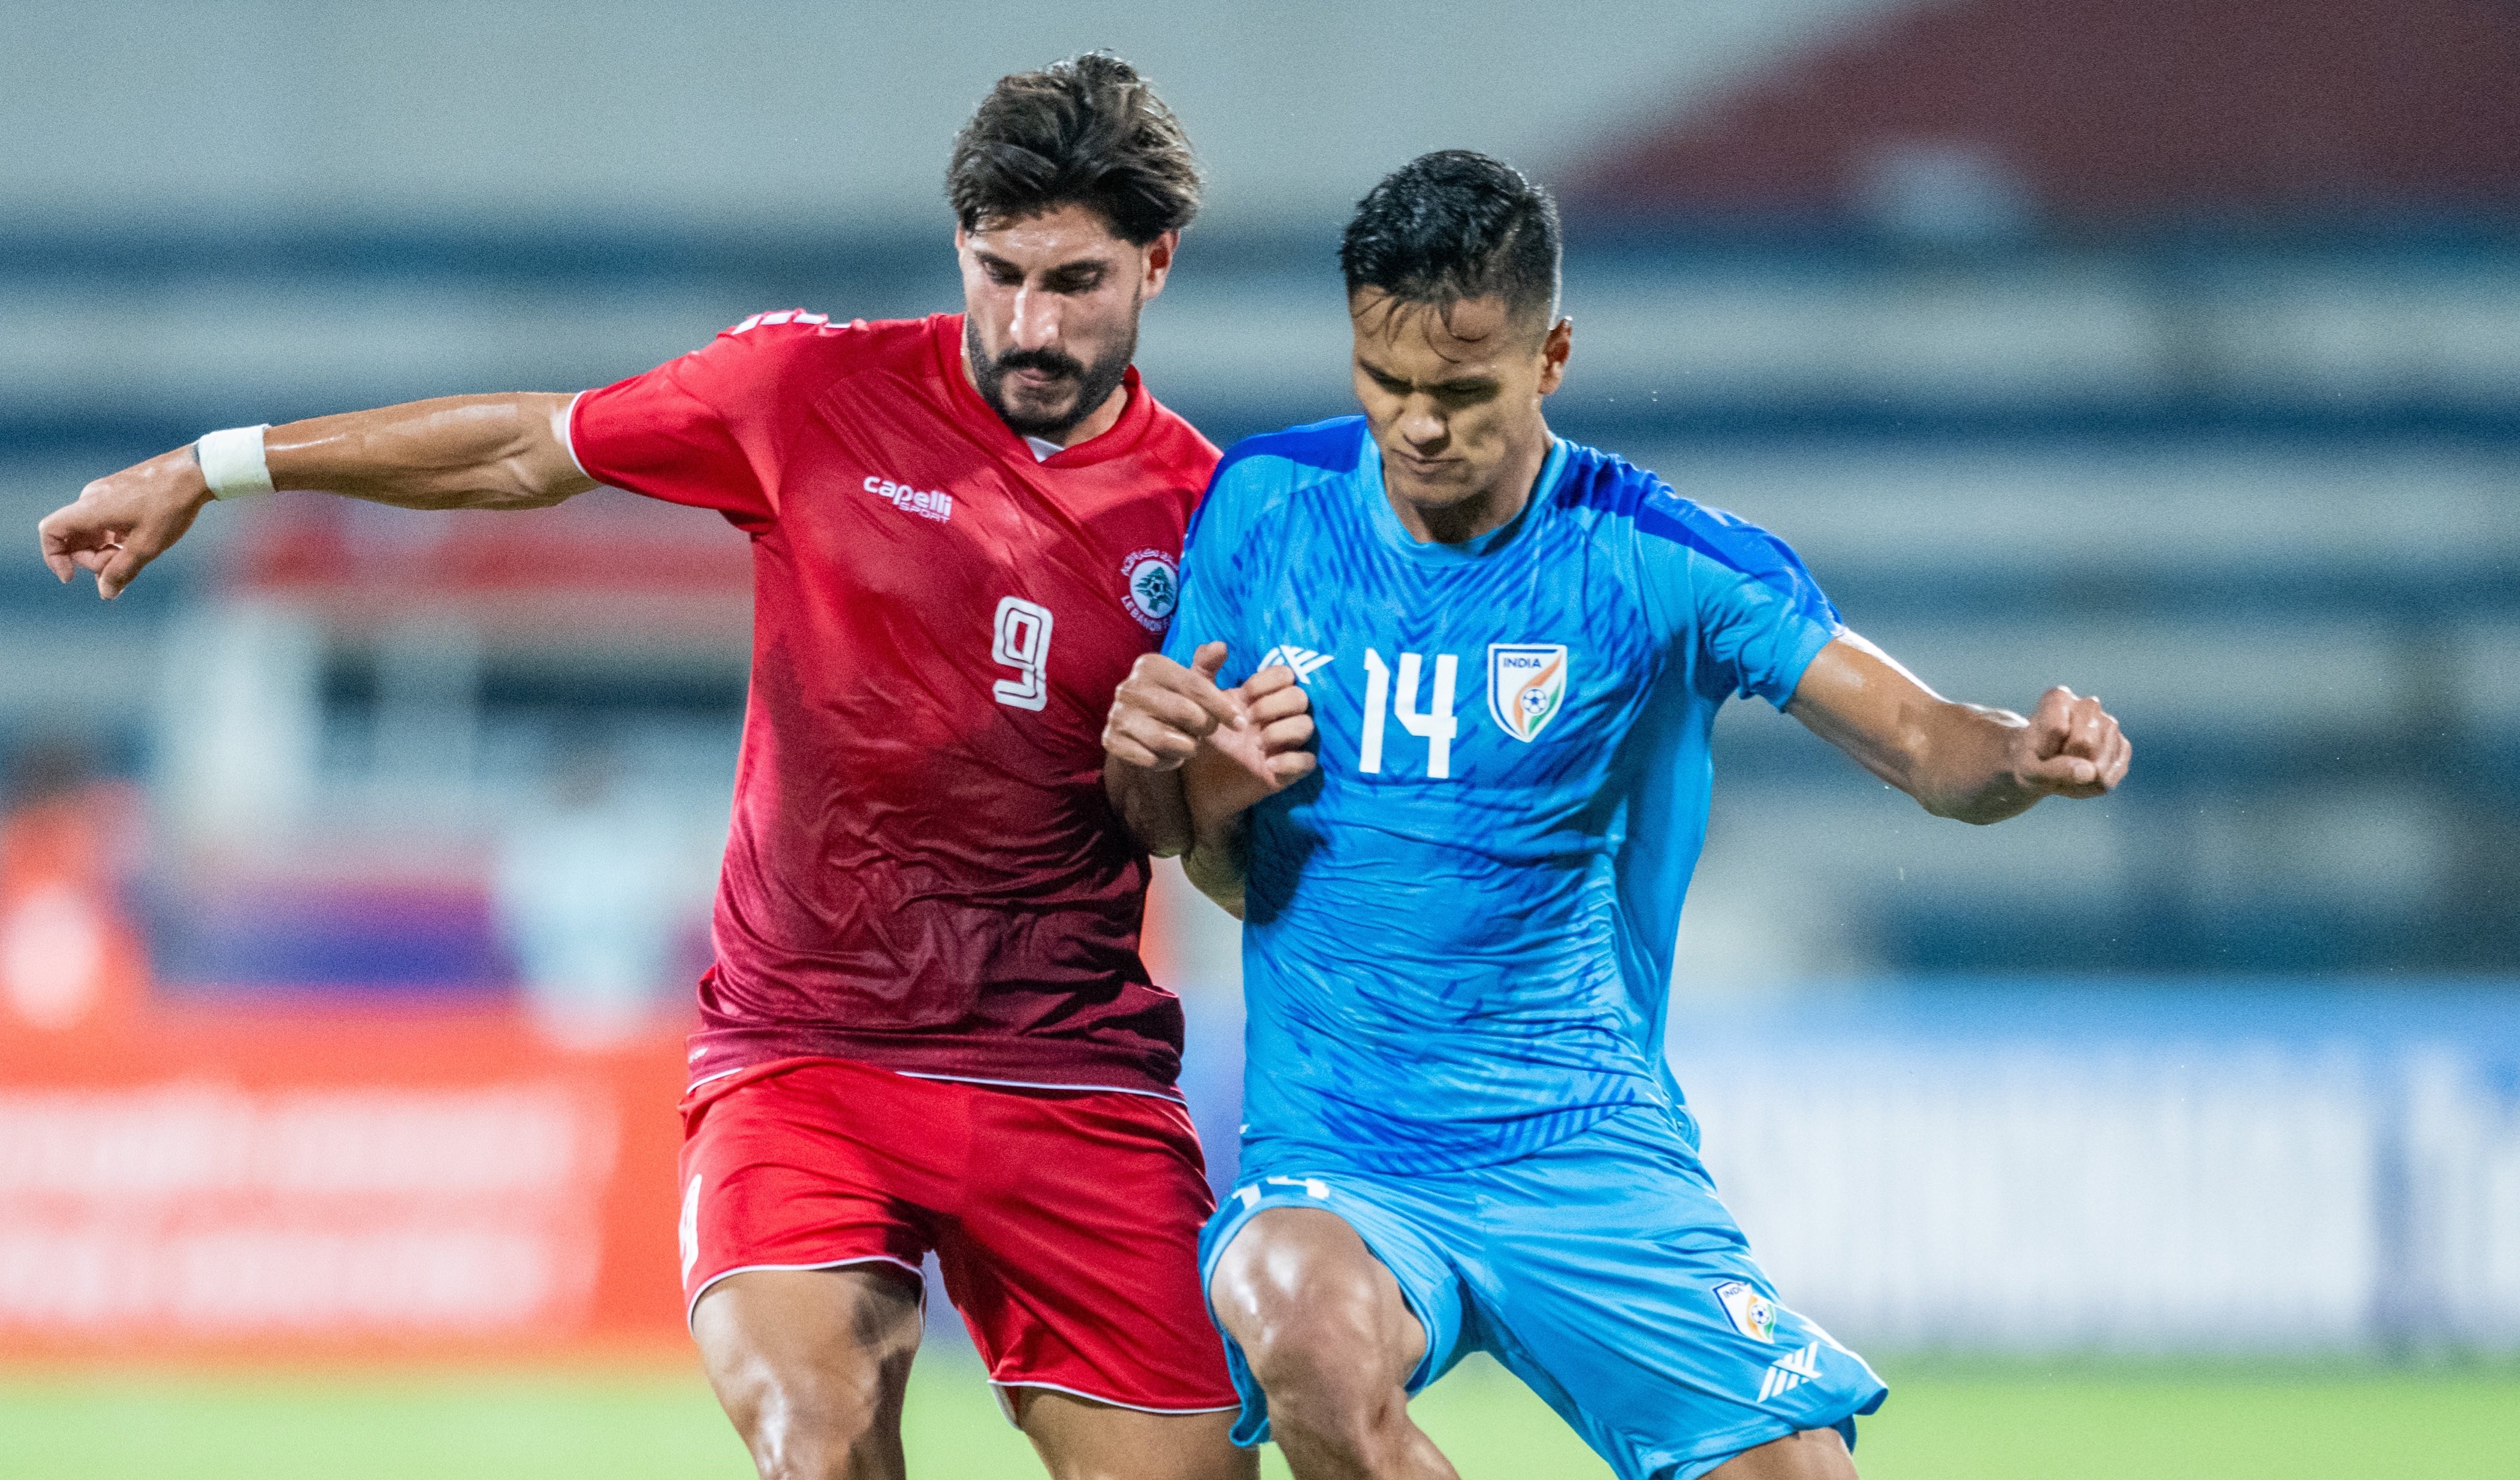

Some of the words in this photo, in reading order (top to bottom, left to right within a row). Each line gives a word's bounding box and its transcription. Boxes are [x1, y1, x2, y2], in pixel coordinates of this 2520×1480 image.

[863, 475, 952, 517] capelli
[898, 503, 951, 524] SPORT
[992, 596, 1053, 712] 9
[1503, 658, 1542, 669] INDIA
[1359, 647, 1458, 779] 14
